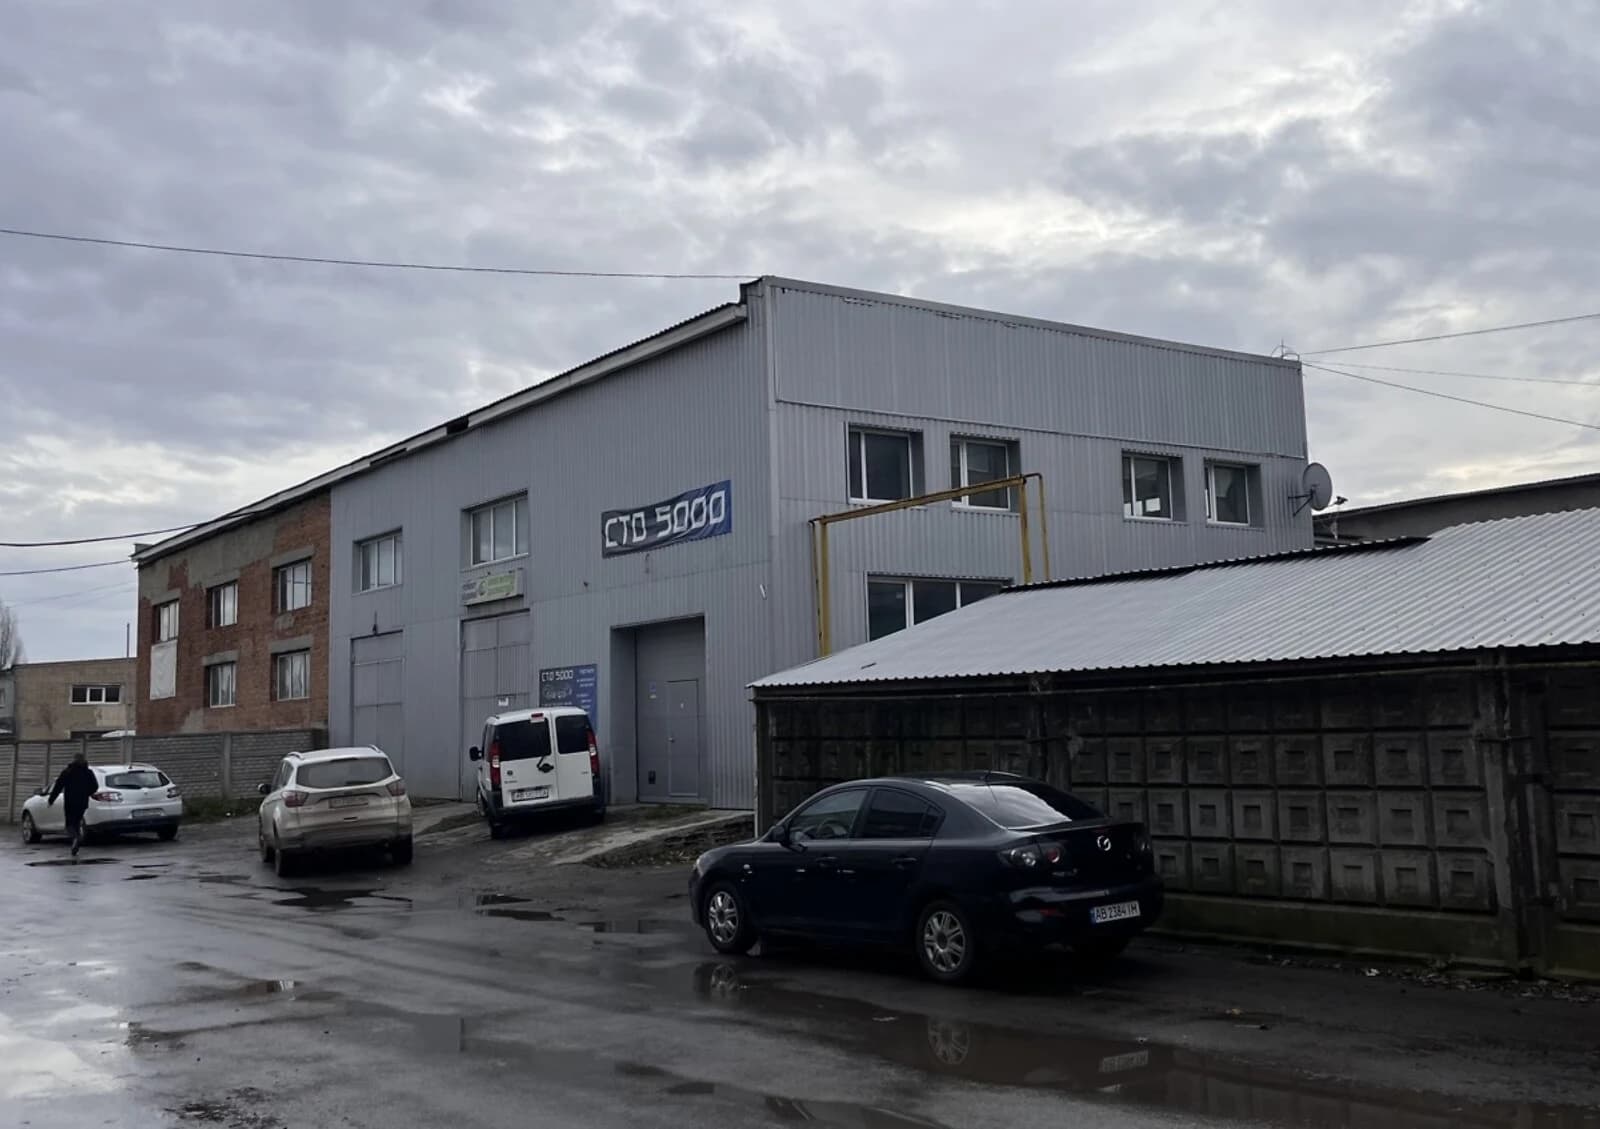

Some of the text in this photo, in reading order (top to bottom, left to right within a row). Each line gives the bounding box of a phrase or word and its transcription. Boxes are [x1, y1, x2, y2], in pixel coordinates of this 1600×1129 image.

[605, 490, 725, 548] СТО 5000
[555, 670, 573, 681] 5000
